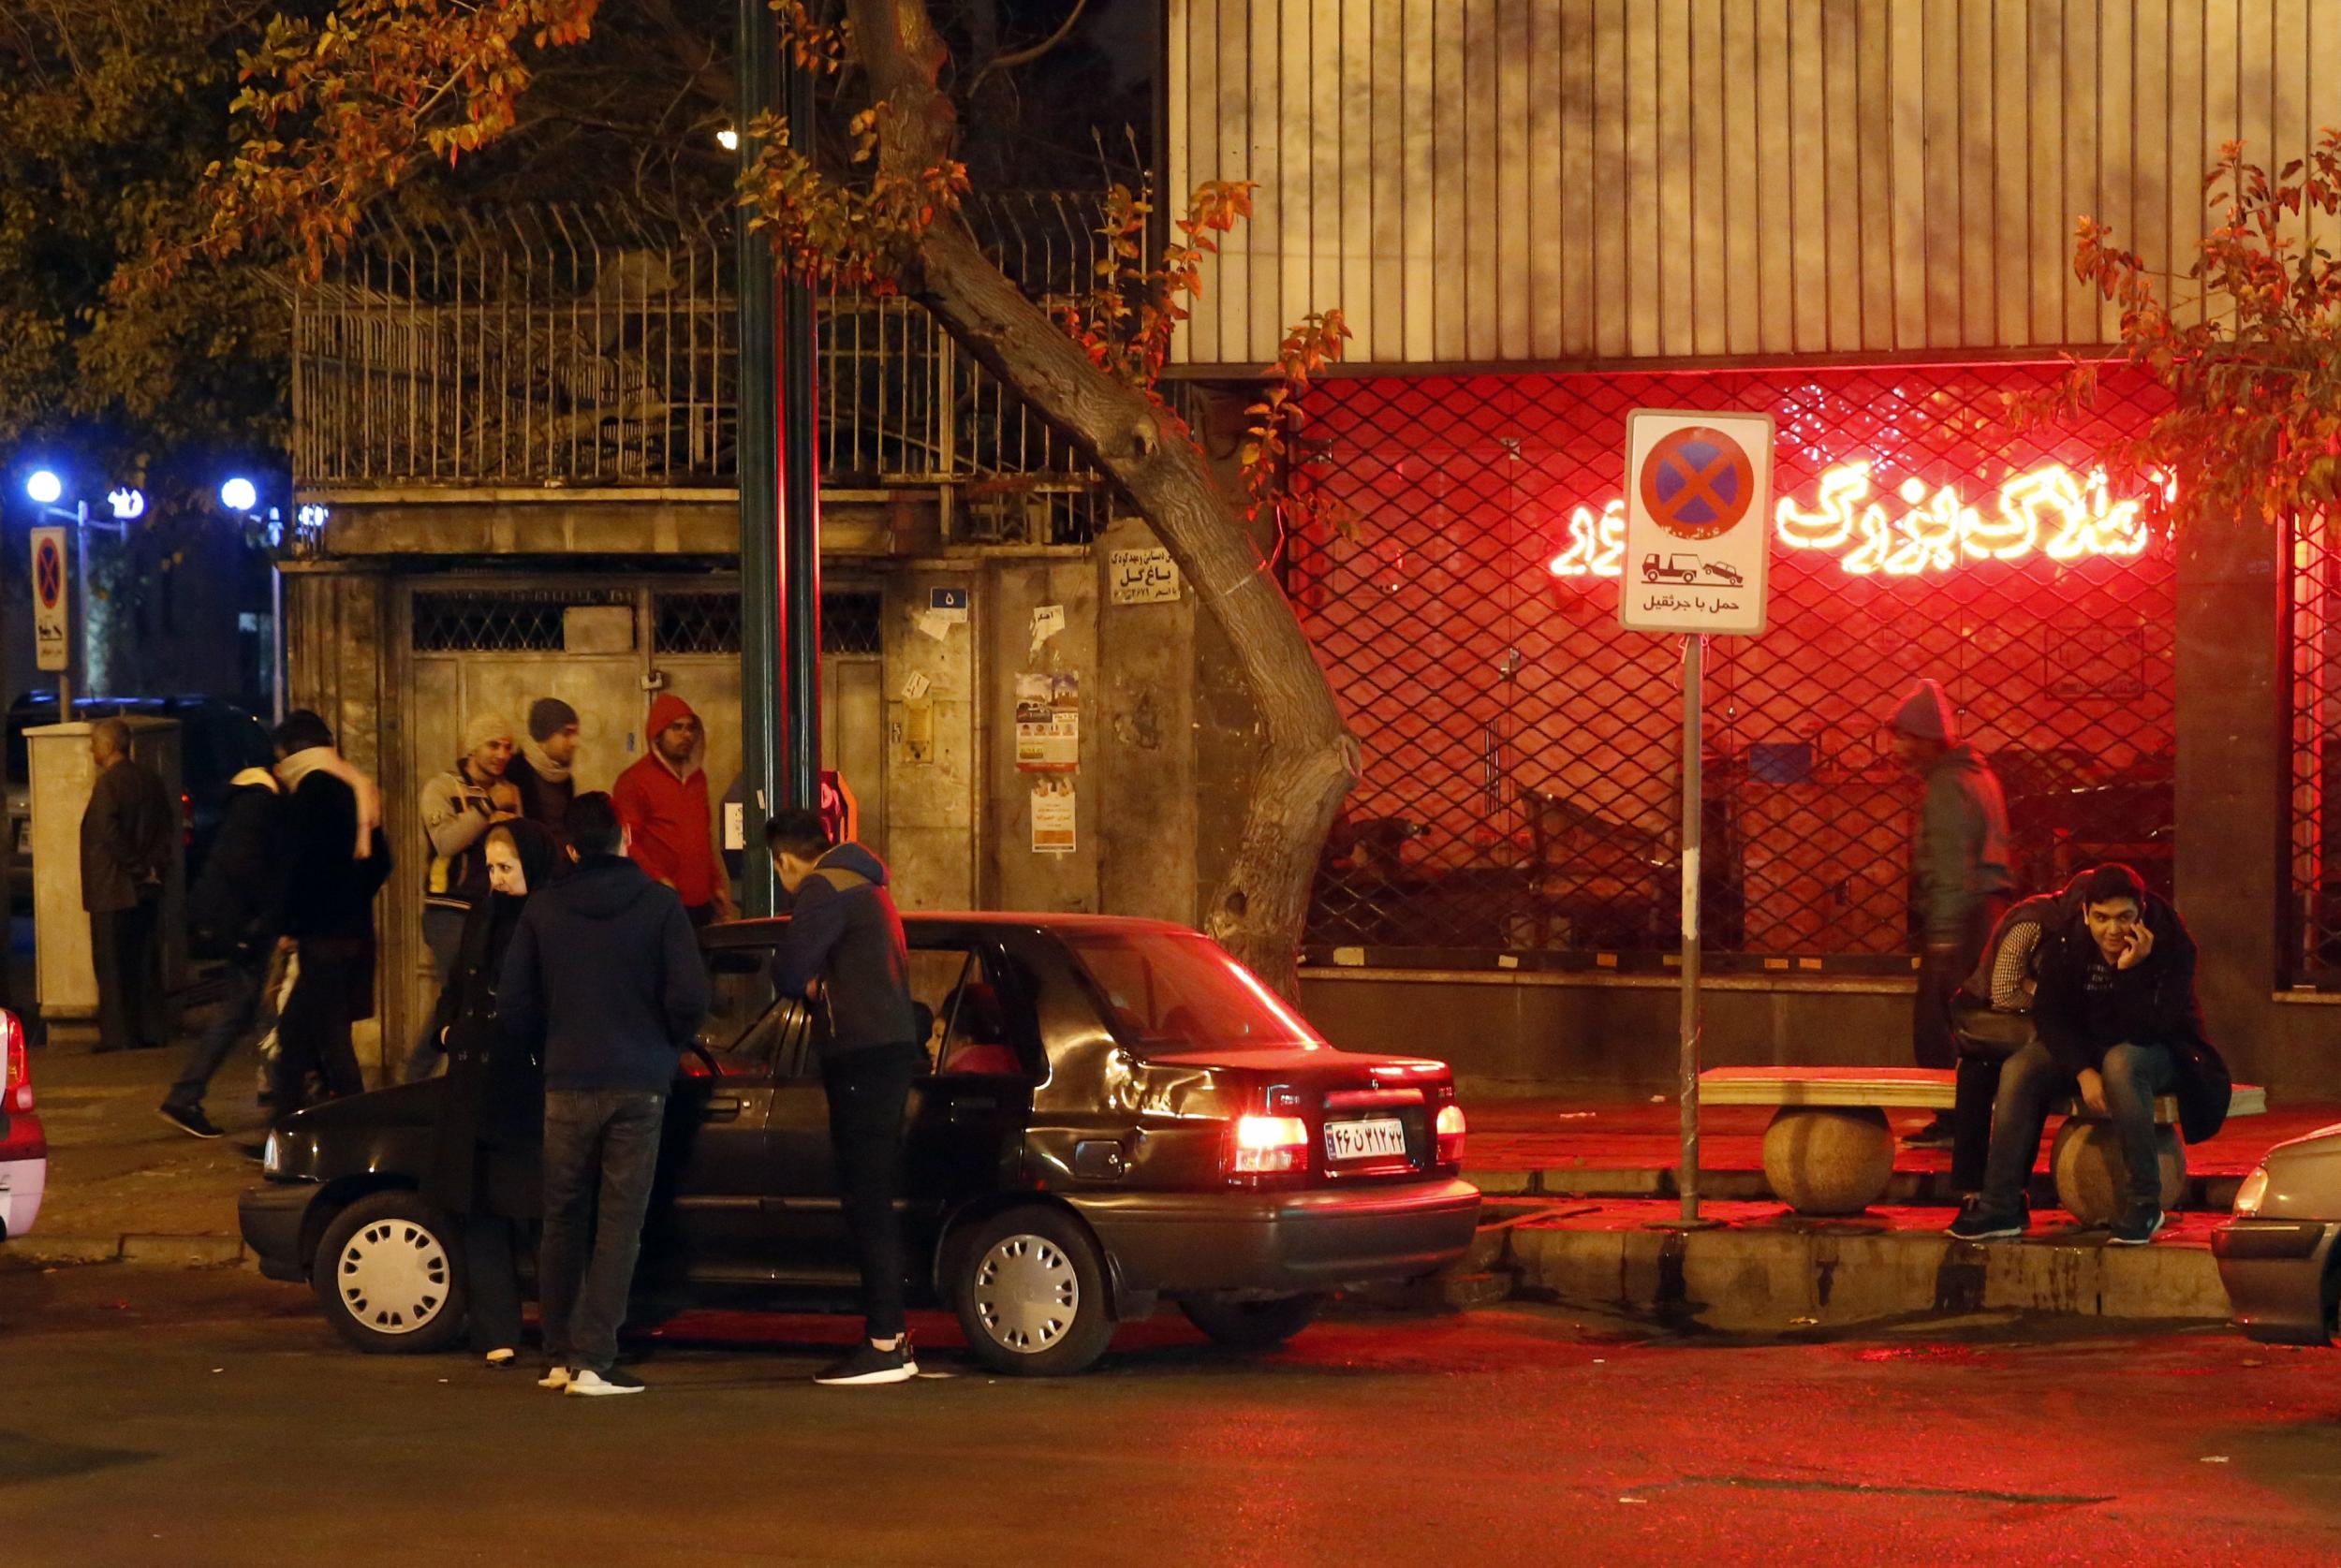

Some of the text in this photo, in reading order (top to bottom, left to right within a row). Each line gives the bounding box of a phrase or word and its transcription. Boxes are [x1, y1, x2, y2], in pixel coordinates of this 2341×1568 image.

[1776, 462, 1960, 574] بزرگ
[1145, 565, 1170, 586] باغ
[945, 592, 954, 605] ۵
[1642, 593, 1740, 614] حمل با جرثقیل
